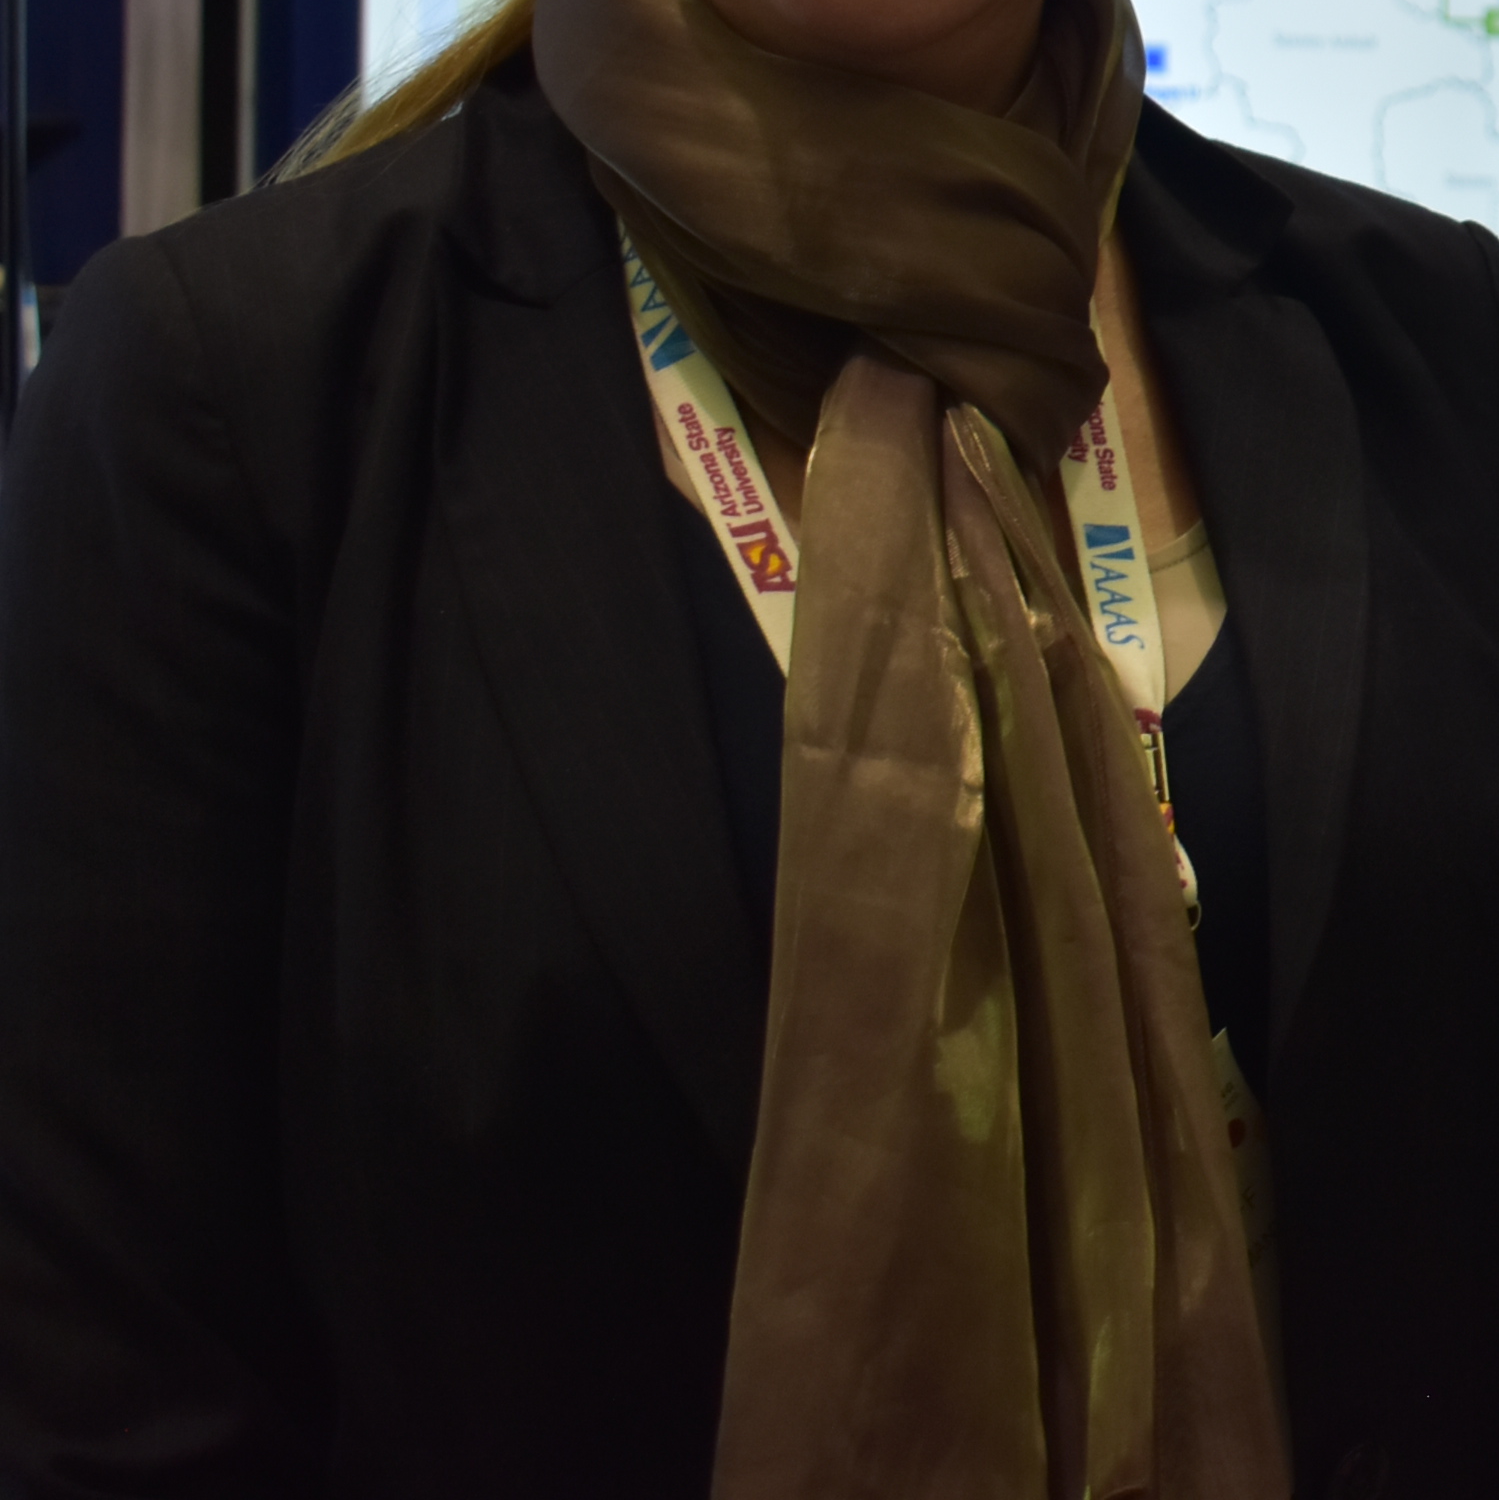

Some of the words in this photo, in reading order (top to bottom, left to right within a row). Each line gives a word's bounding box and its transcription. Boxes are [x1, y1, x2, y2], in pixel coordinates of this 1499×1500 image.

[676, 402, 711, 453] State
[700, 452, 740, 518] Arizona
[713, 426, 765, 515] University
[728, 517, 797, 595] ASU
[1088, 560, 1146, 651] AAAS
